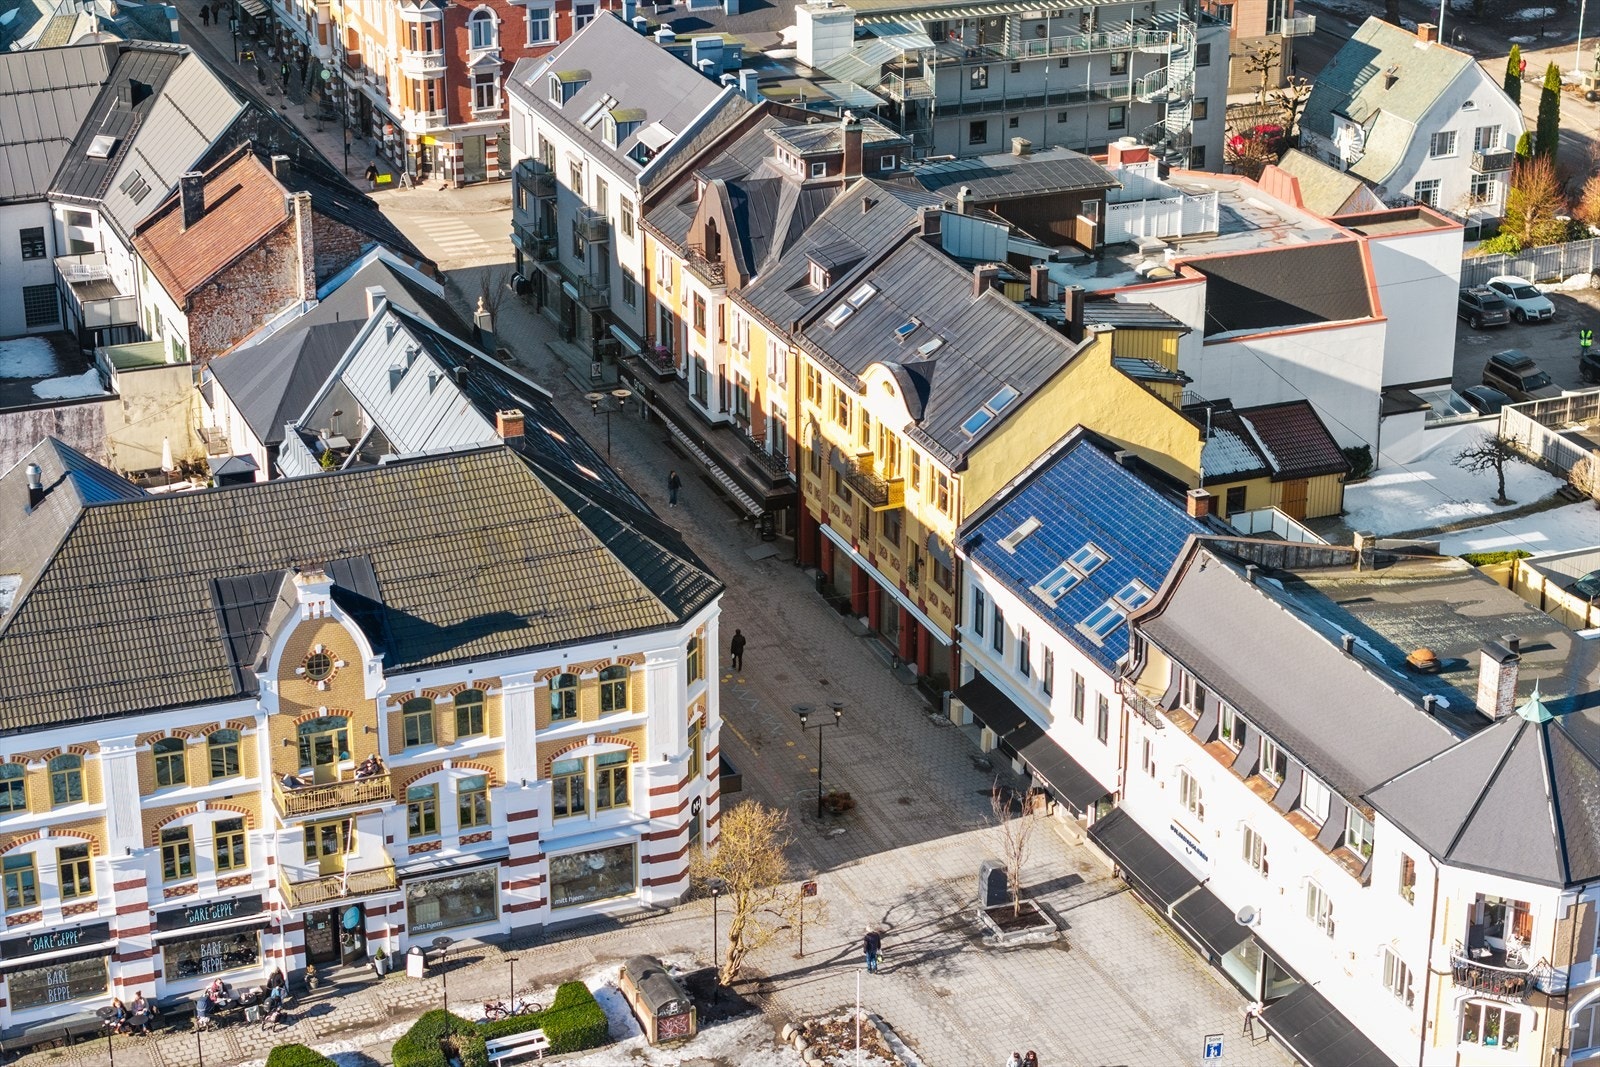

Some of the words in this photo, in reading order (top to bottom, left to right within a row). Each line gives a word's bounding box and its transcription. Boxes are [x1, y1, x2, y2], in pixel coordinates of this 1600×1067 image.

[412, 923, 426, 931] mitt
[33, 936, 55, 951] BARE
[200, 940, 221, 957] BARE
[201, 957, 224, 974] BEPPE
[46, 968, 70, 986] BARE
[48, 985, 71, 1003] BEPPE
